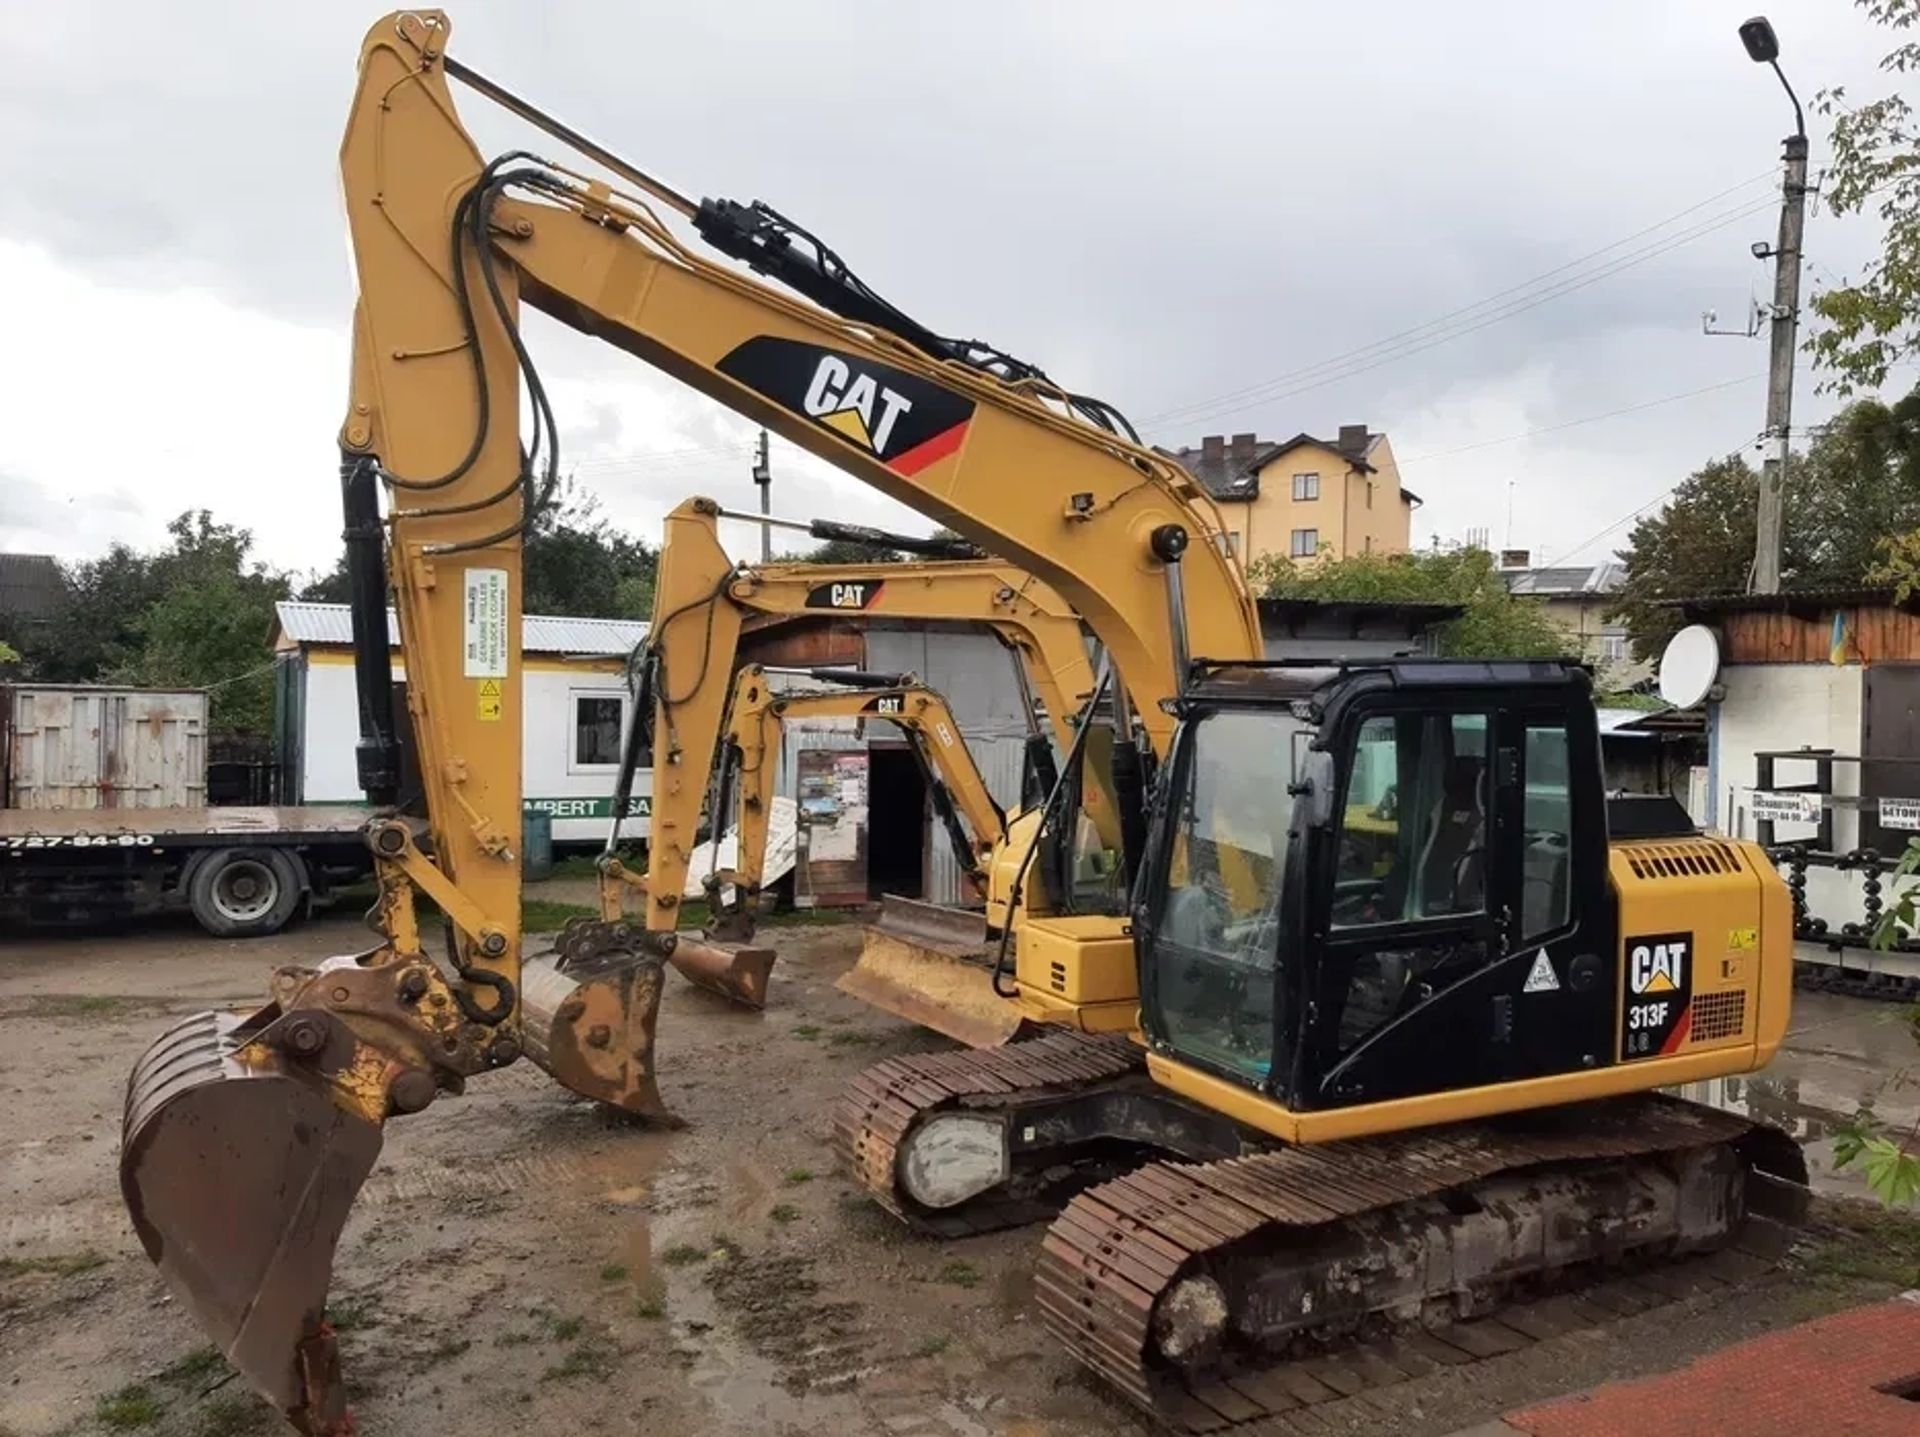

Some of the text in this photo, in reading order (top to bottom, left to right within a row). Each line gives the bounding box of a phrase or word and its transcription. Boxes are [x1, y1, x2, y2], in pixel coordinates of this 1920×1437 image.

[804, 355, 912, 454] CAT
[831, 584, 864, 607] CAT
[878, 698, 900, 713] CAT
[1631, 942, 1687, 994] CAT
[1629, 1002, 1669, 1029] 313F
